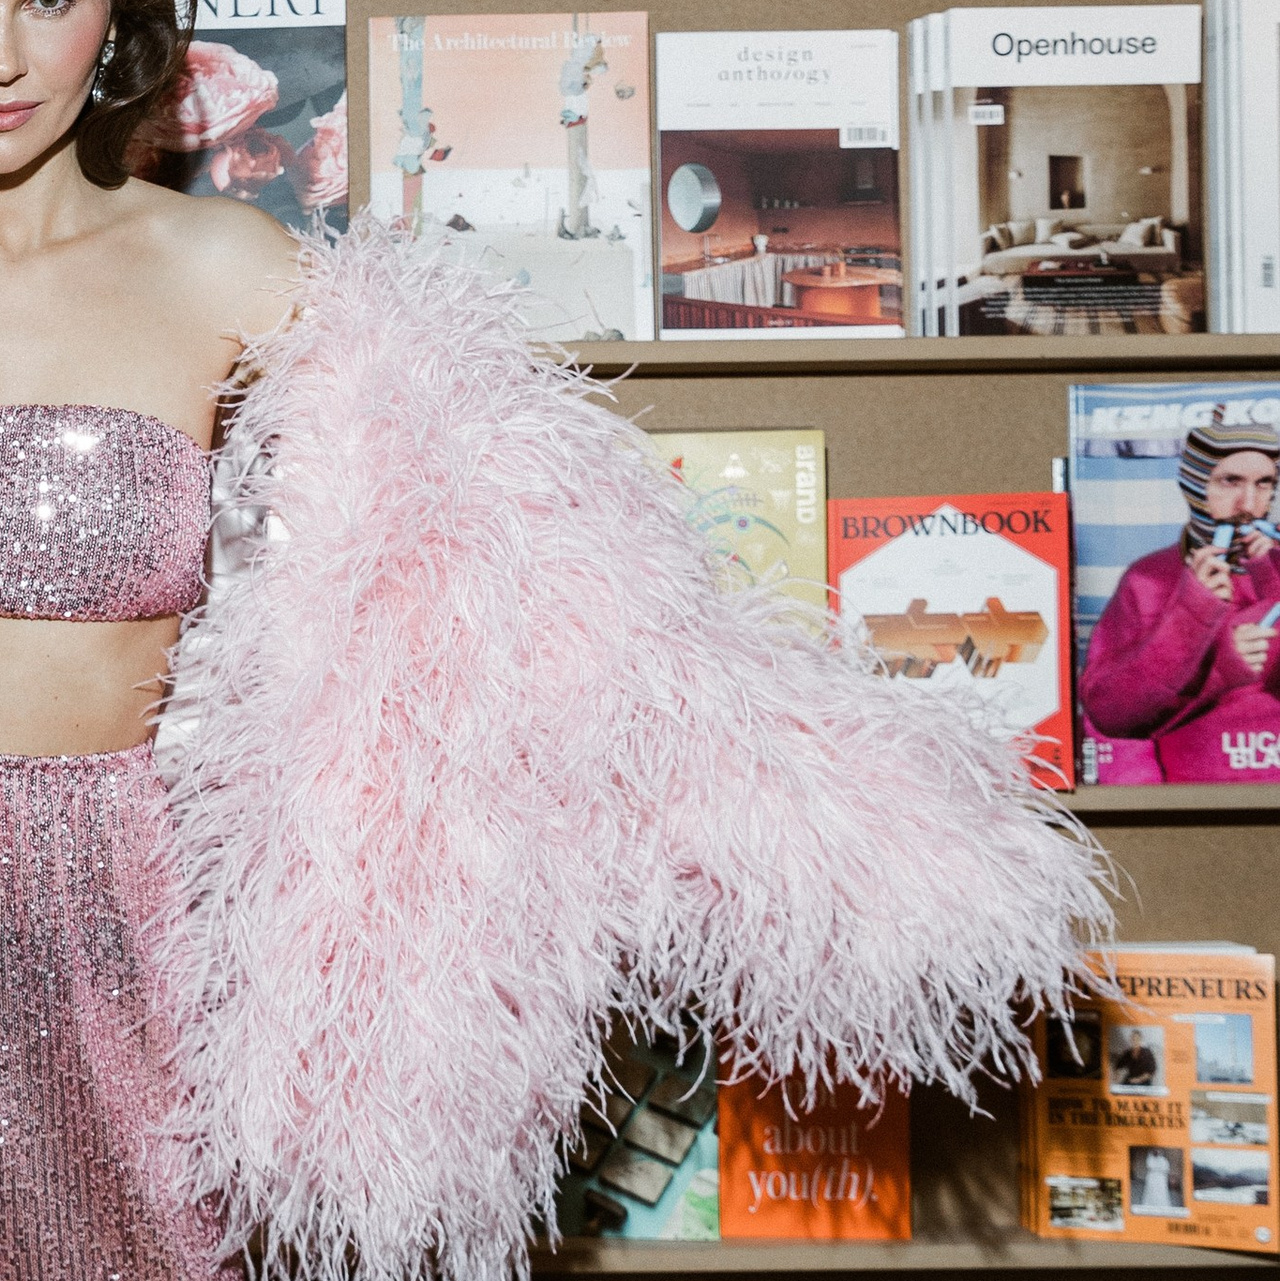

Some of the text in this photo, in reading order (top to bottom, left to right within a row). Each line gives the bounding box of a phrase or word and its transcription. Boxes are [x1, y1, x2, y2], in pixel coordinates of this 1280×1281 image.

[388, 32, 423, 52] The
[432, 32, 558, 52] Architectural
[992, 32, 1158, 63] Openhouse
[737, 46, 814, 66] design
[718, 66, 831, 85] anthology
[842, 508, 1053, 540] BROWNBOOK
[1117, 1100, 1161, 1114] MAKE
[763, 1113, 859, 1155] about
[748, 1157, 879, 1214] you(th).
